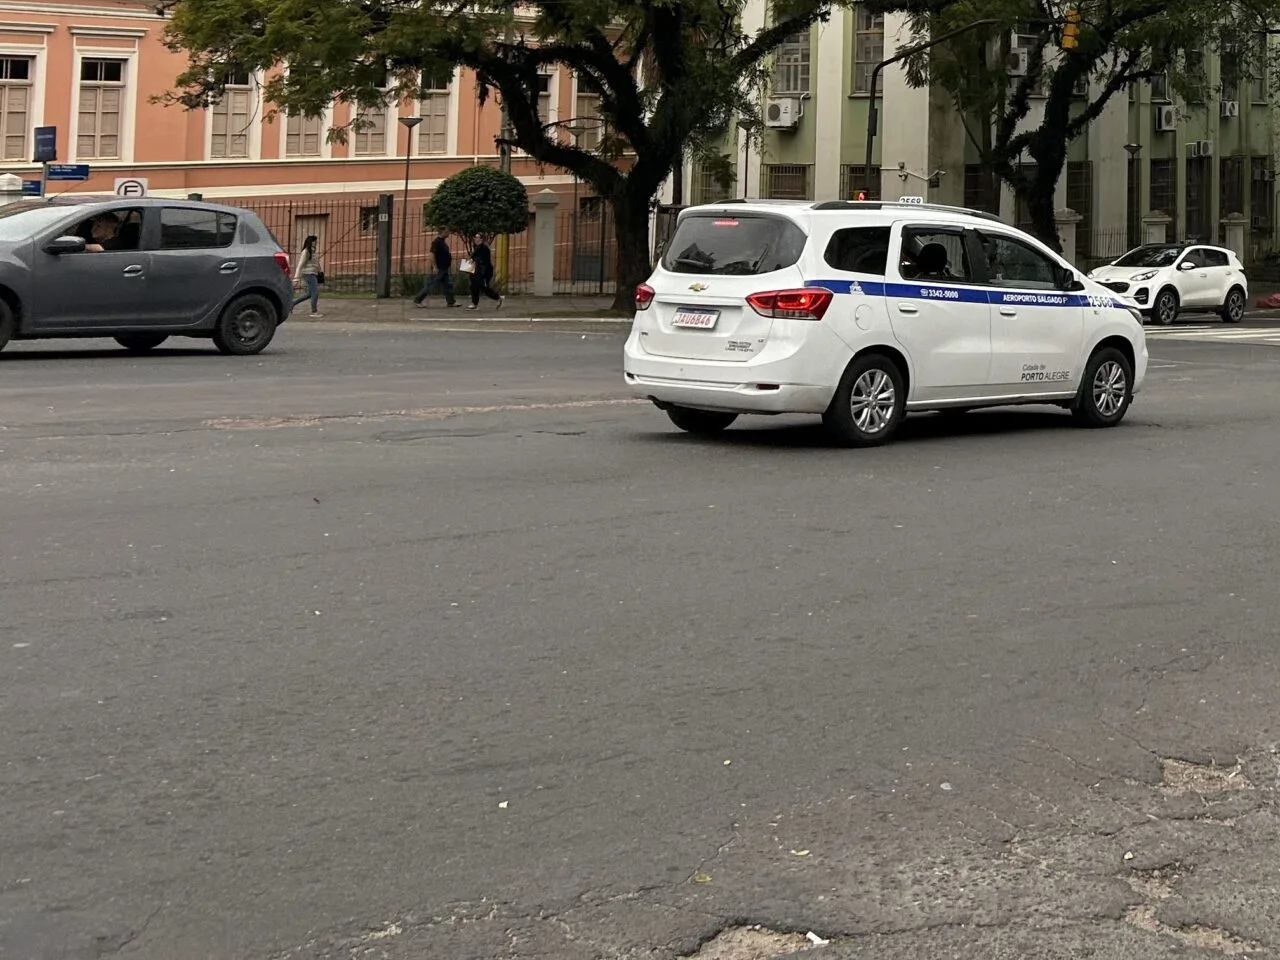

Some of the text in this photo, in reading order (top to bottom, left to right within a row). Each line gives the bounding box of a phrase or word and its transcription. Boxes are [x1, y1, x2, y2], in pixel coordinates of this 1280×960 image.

[1002, 294, 1037, 303] AEROPORTO
[1037, 295, 1063, 304] SALGADO
[1021, 371, 1070, 381] PORTO ALEGRE
